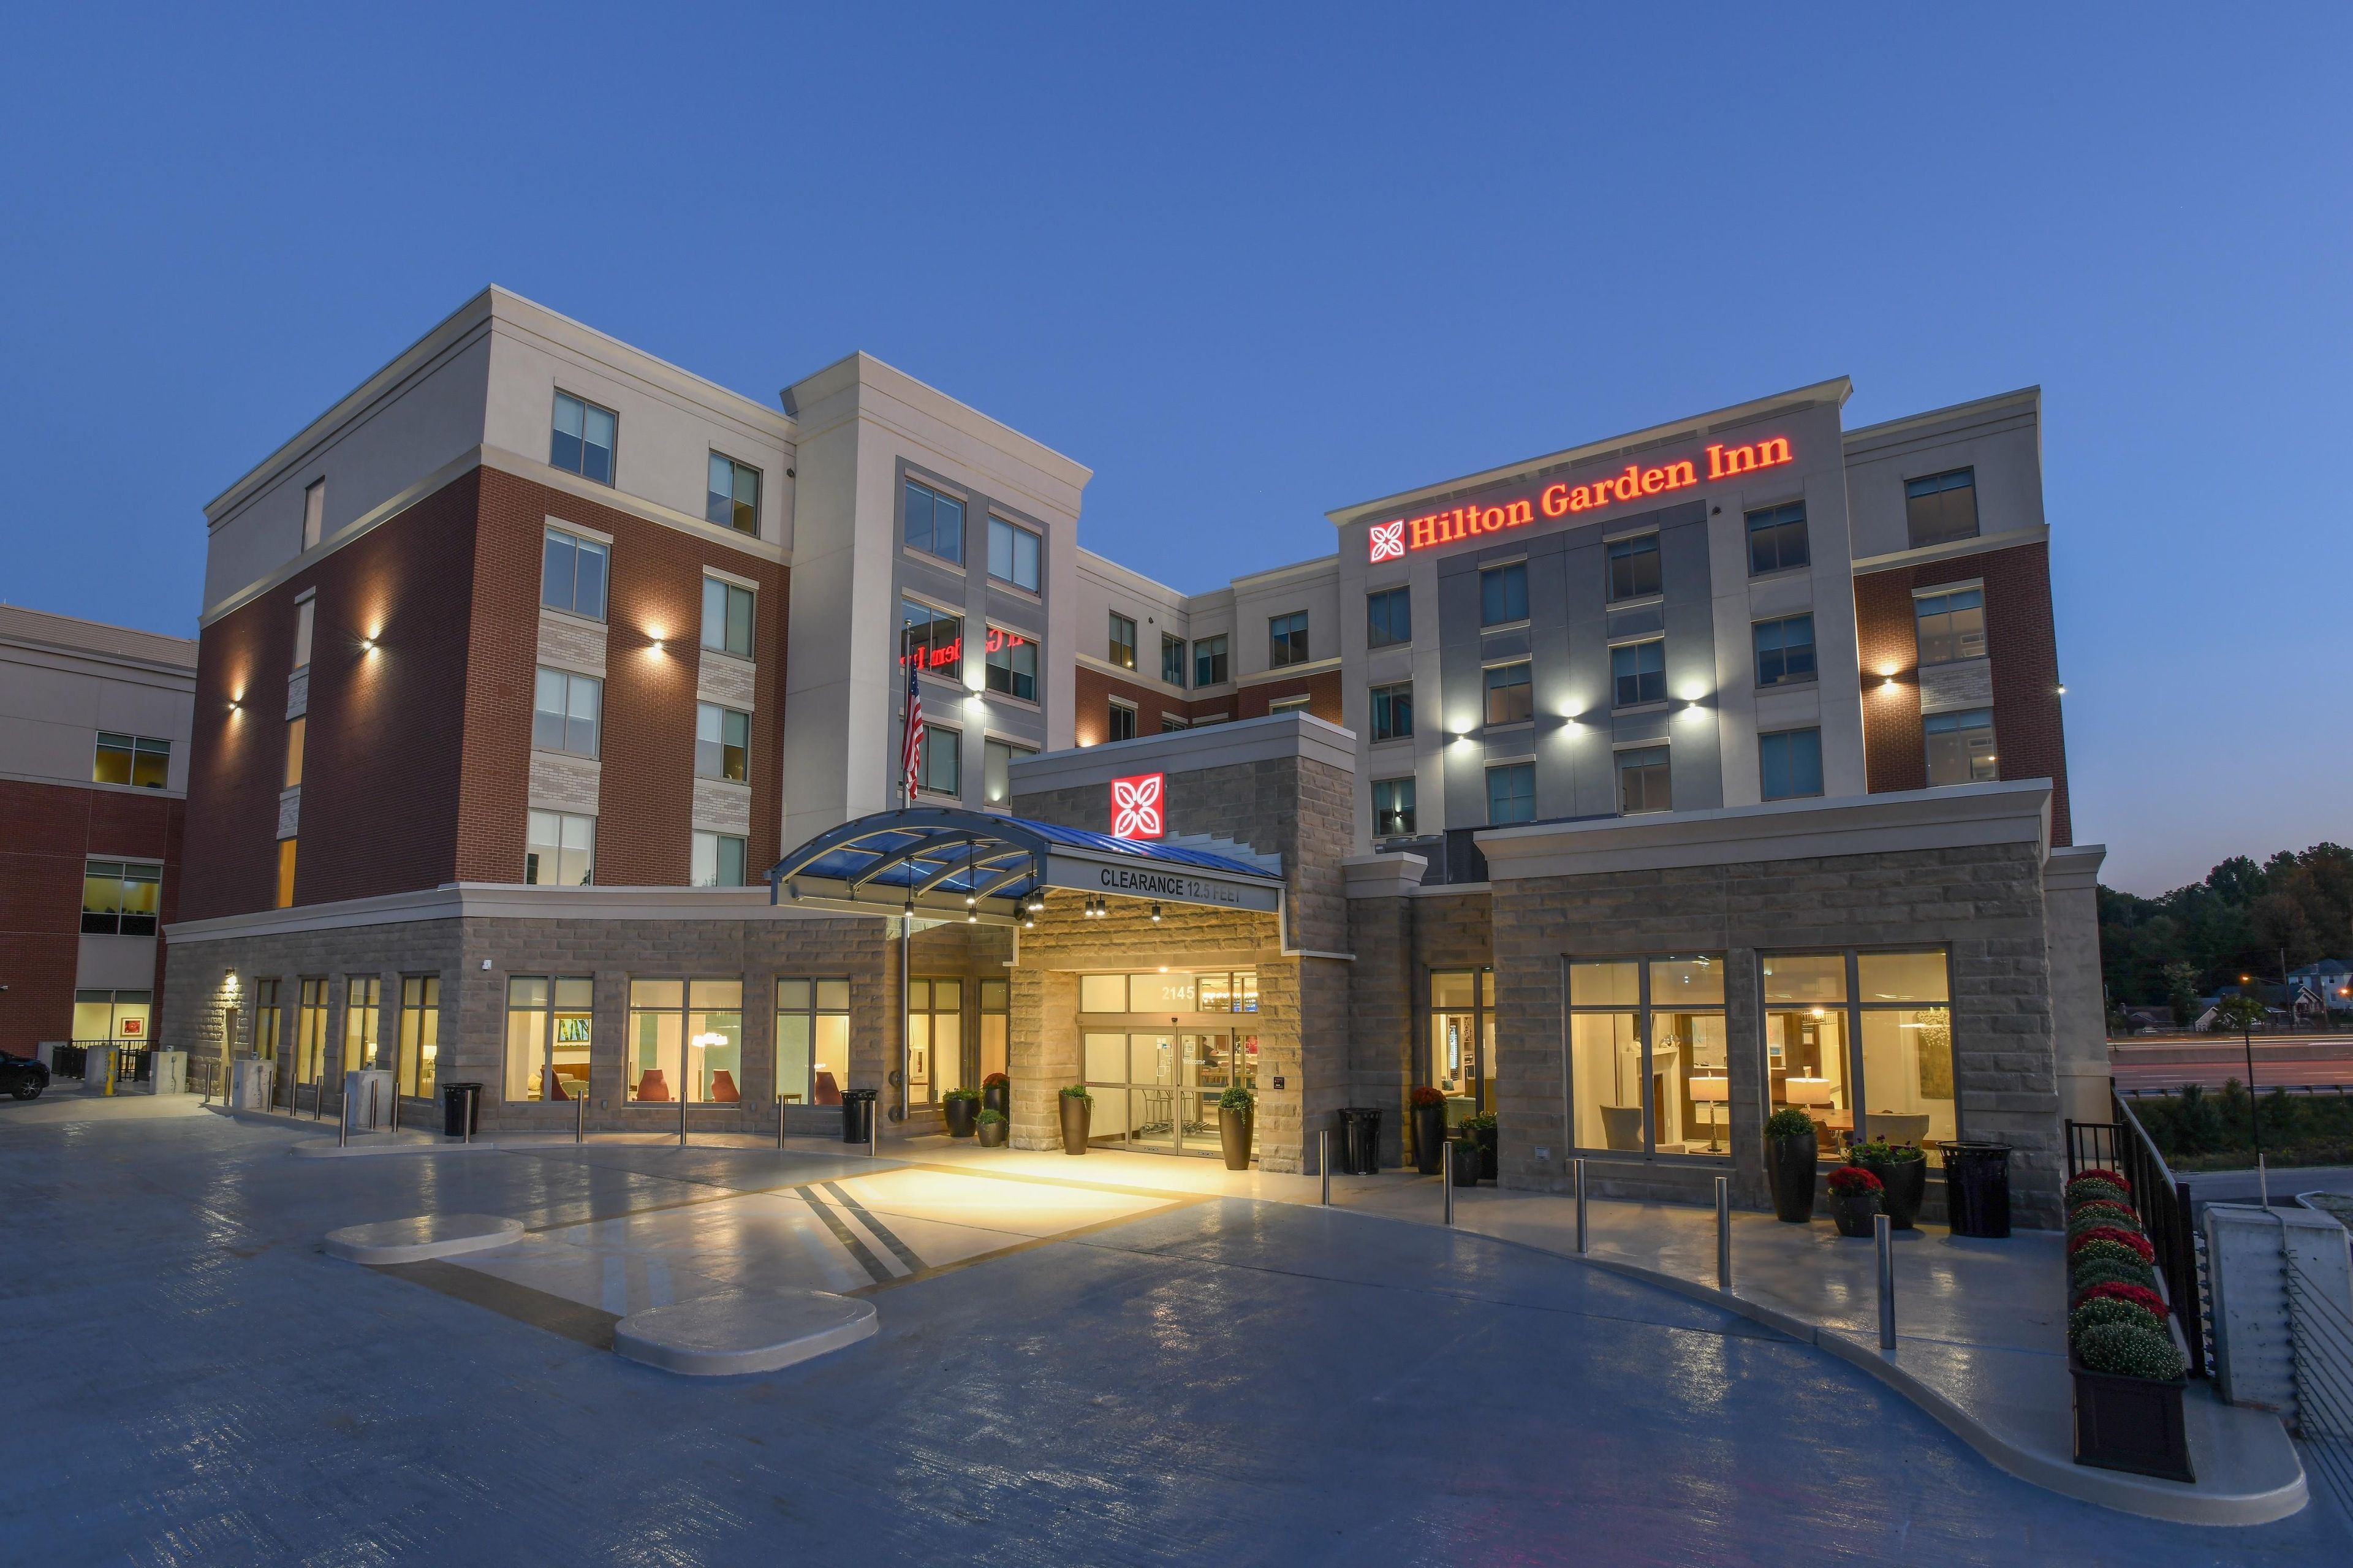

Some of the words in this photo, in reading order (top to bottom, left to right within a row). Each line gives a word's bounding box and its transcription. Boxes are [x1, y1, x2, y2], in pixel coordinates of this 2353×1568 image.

[1409, 506, 1534, 550] Hilton
[1541, 461, 1697, 517] Garden
[1706, 437, 1792, 480] Inn
[1101, 869, 1183, 895] CLEARANCE
[1188, 881, 1210, 899] 12.5
[1162, 987, 1194, 1000] 2145
